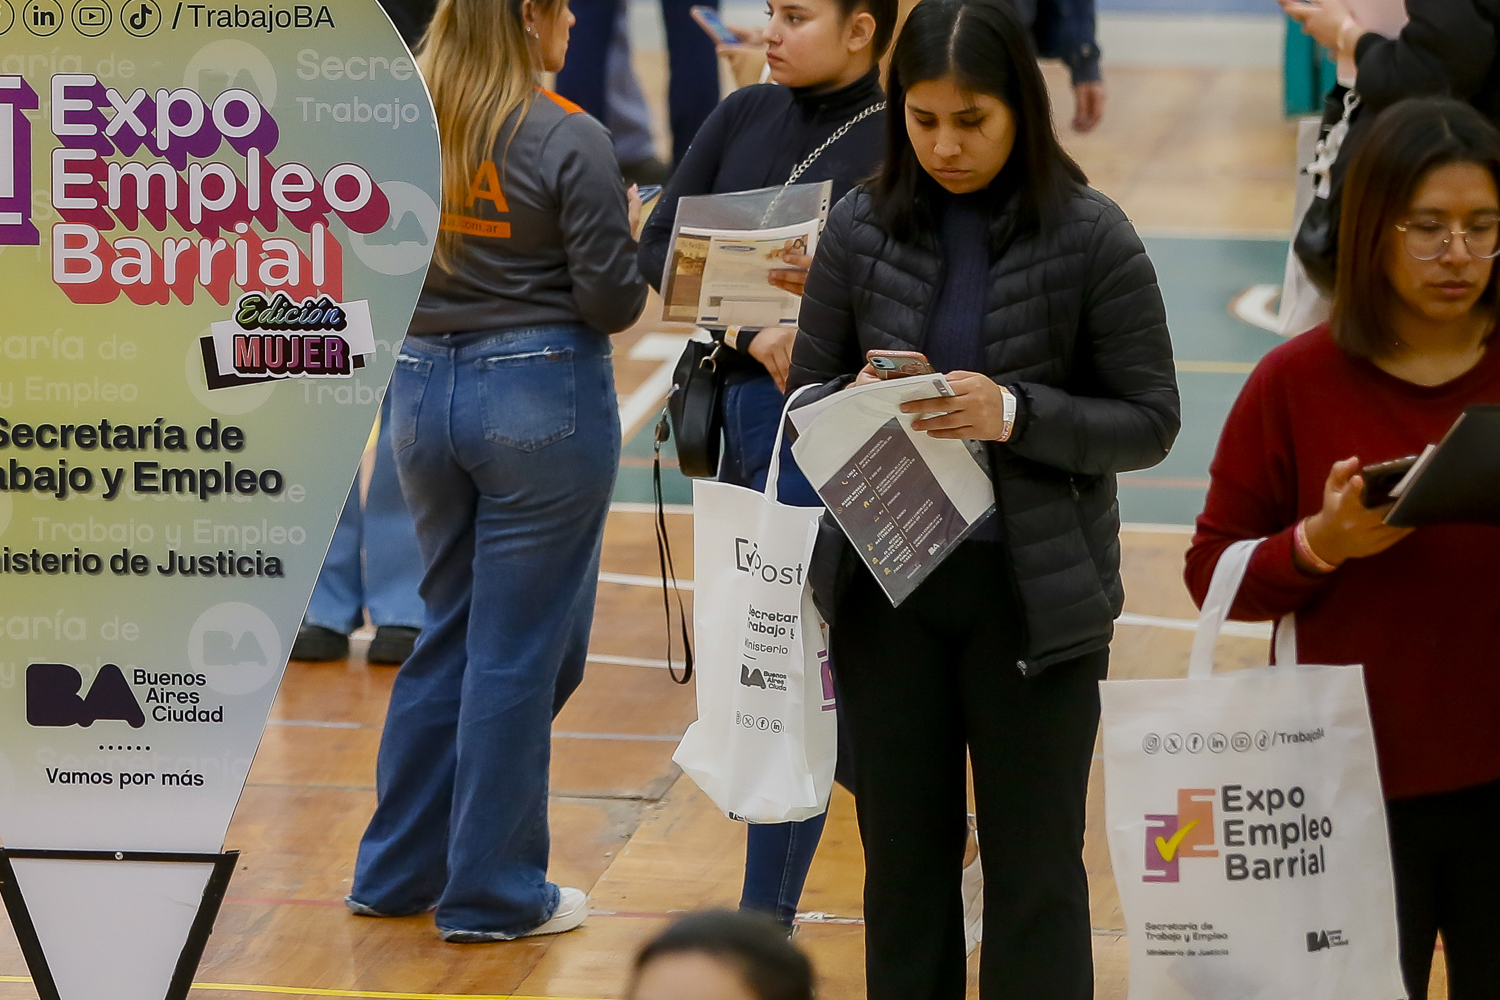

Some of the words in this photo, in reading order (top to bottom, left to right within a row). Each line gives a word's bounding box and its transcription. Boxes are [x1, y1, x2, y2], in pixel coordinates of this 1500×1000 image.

[172, 2, 336, 33] /TrabajoBA
[96, 53, 135, 79] de
[50, 73, 266, 154] Expo
[299, 96, 420, 130] Trabajo
[50, 146, 376, 228] Empleo
[50, 221, 328, 290] Barrial
[236, 295, 342, 326] Edición
[98, 334, 138, 360] de
[234, 335, 345, 369] MUJER
[25, 375, 138, 408] Empleo
[195, 418, 244, 450] de
[100, 467, 124, 499] y
[133, 461, 283, 499] Empleo
[32, 517, 154, 551] Trabajo
[165, 524, 182, 550] y
[193, 518, 307, 551] Empleo
[109, 547, 149, 575] de
[156, 549, 284, 577] Justicia
[100, 615, 140, 642] de
[134, 669, 207, 686] Buenos
[26, 663, 146, 729] BA
[145, 688, 201, 704] Aires
[152, 705, 224, 723] Ciudad
[46, 768, 113, 786] Vamos
[119, 772, 155, 790] por
[161, 769, 204, 787] más
[1221, 785, 1305, 815] Expo
[1223, 814, 1332, 849] Empleo
[1225, 845, 1325, 881] Barrial
